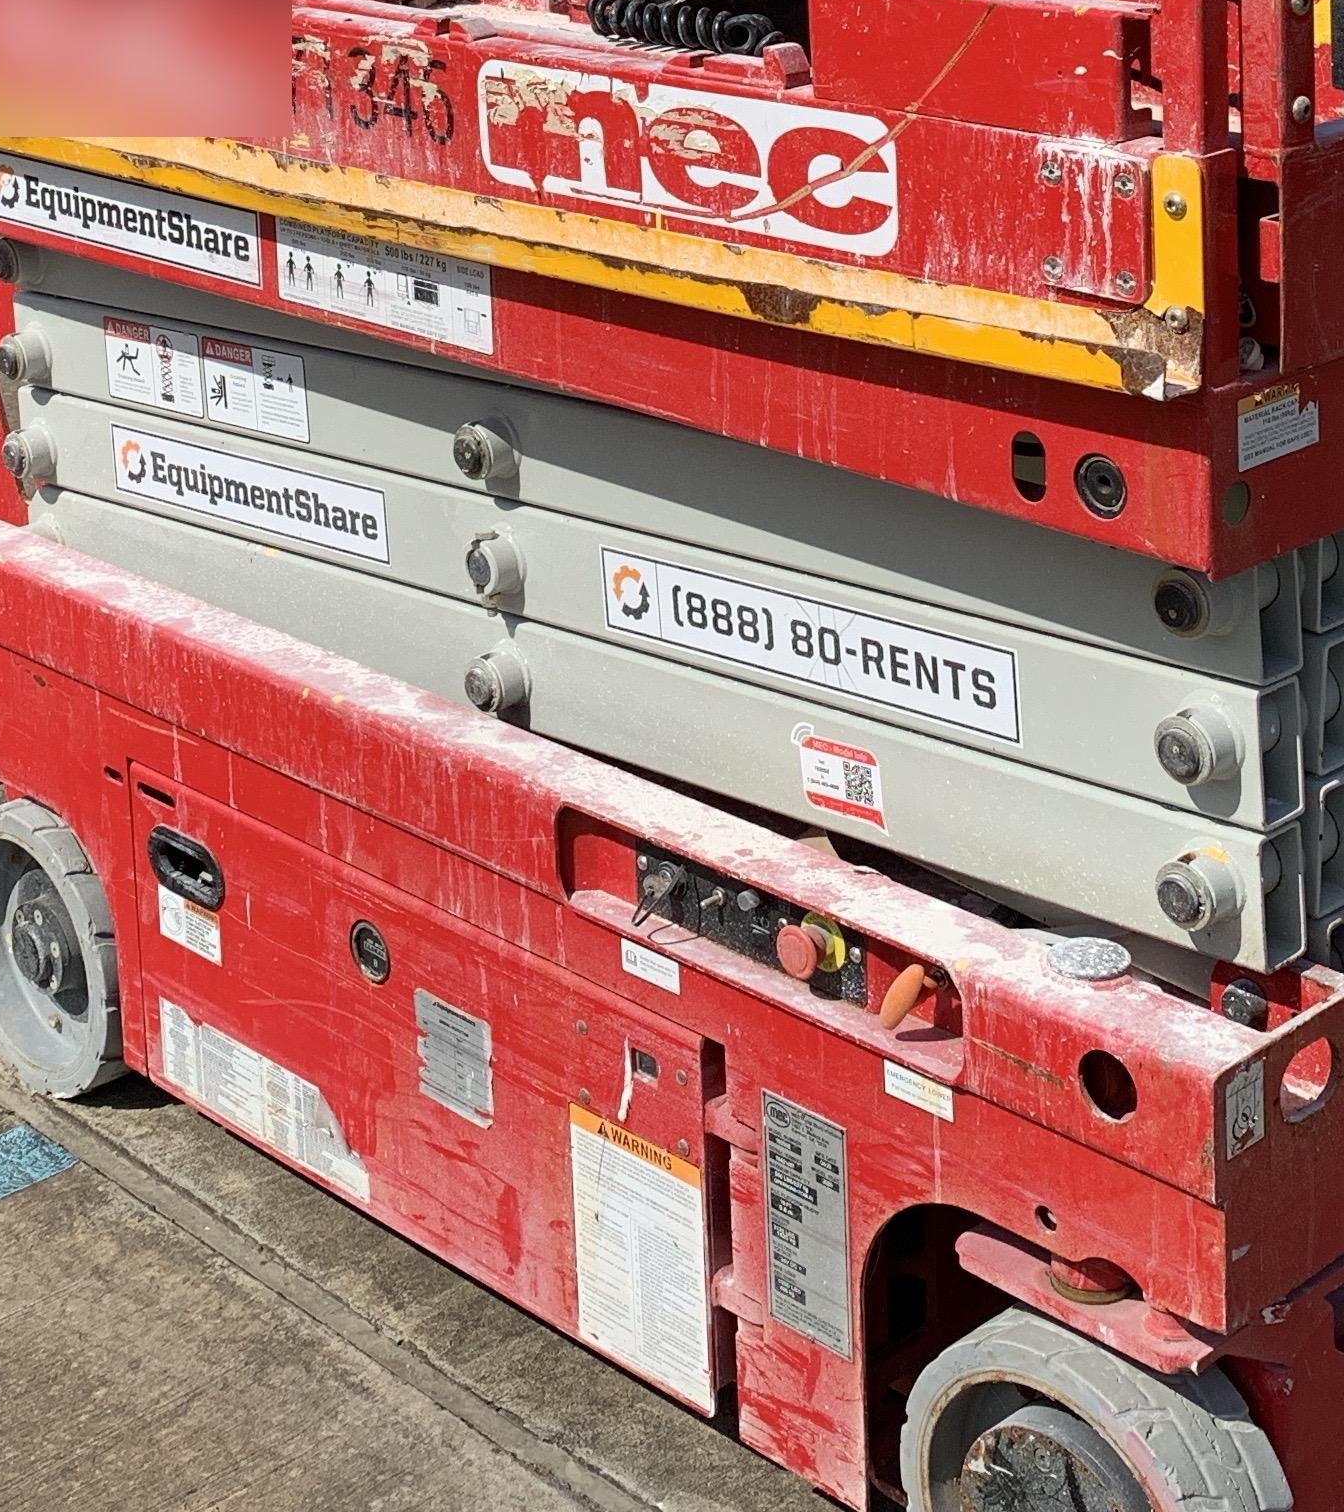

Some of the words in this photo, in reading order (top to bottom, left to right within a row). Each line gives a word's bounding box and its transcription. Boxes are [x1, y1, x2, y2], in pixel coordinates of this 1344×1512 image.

[487, 68, 892, 233] mec
[24, 174, 250, 264] EquipmentShare
[385, 245, 399, 257] 500
[401, 249, 413, 262] lbs
[420, 253, 434, 267] 227
[436, 258, 447, 273] kg
[114, 324, 149, 342] DANGER
[216, 344, 251, 363] DANGER
[150, 450, 378, 541] EquipmentShare
[672, 583, 774, 651] (888)
[791, 618, 997, 711] 80-RENTS
[611, 1126, 673, 1171] WARNING
